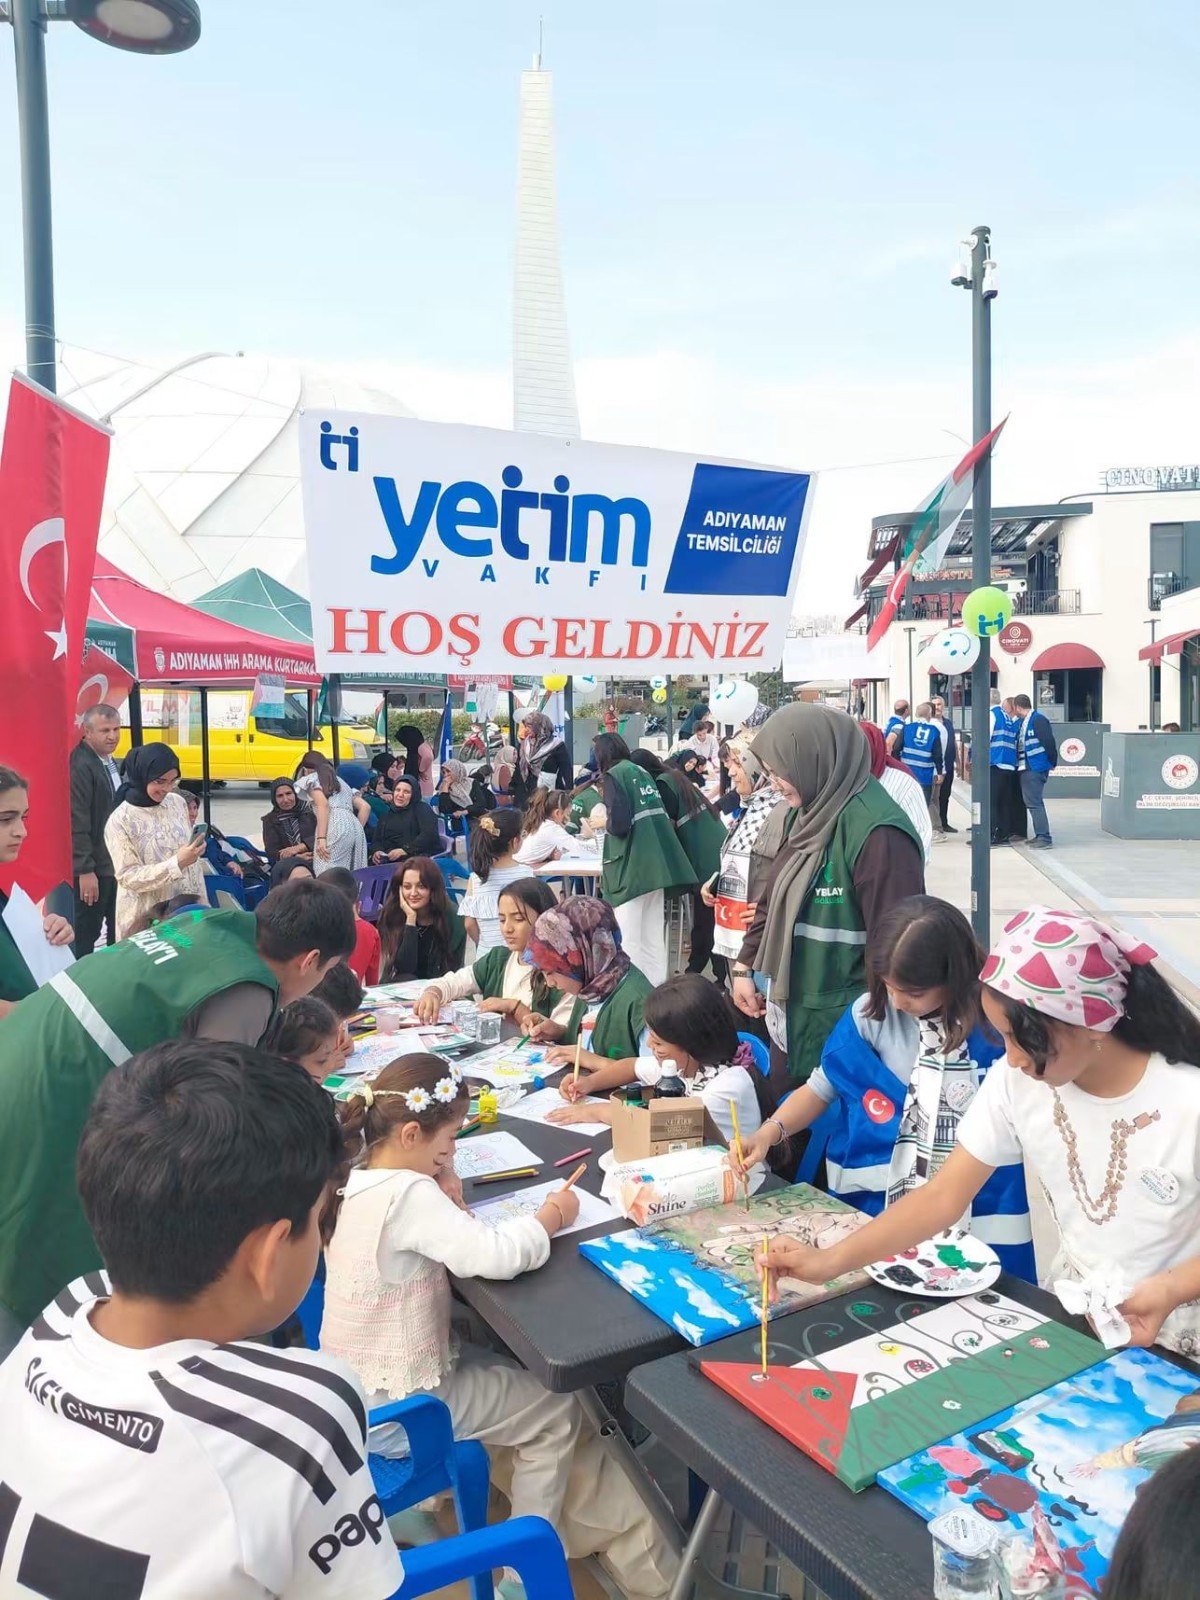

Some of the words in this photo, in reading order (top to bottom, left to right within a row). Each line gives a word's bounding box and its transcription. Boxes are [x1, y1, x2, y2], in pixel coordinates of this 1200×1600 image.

[371, 465, 651, 575] yetim
[702, 510, 787, 532] ADIYAMAN
[686, 532, 783, 555] TEMSİLCİLİĞİ
[421, 558, 647, 591] VAKFI
[326, 607, 482, 666] HOŞ
[501, 610, 770, 660] GELDİNİZ
[169, 651, 223, 671] ADIYAMAN
[223, 653, 241, 670] İHH
[242, 653, 274, 672] ARAMA
[647, 1200, 687, 1216] Shine
[66, 1402, 154, 1442] ÇİMENTO
